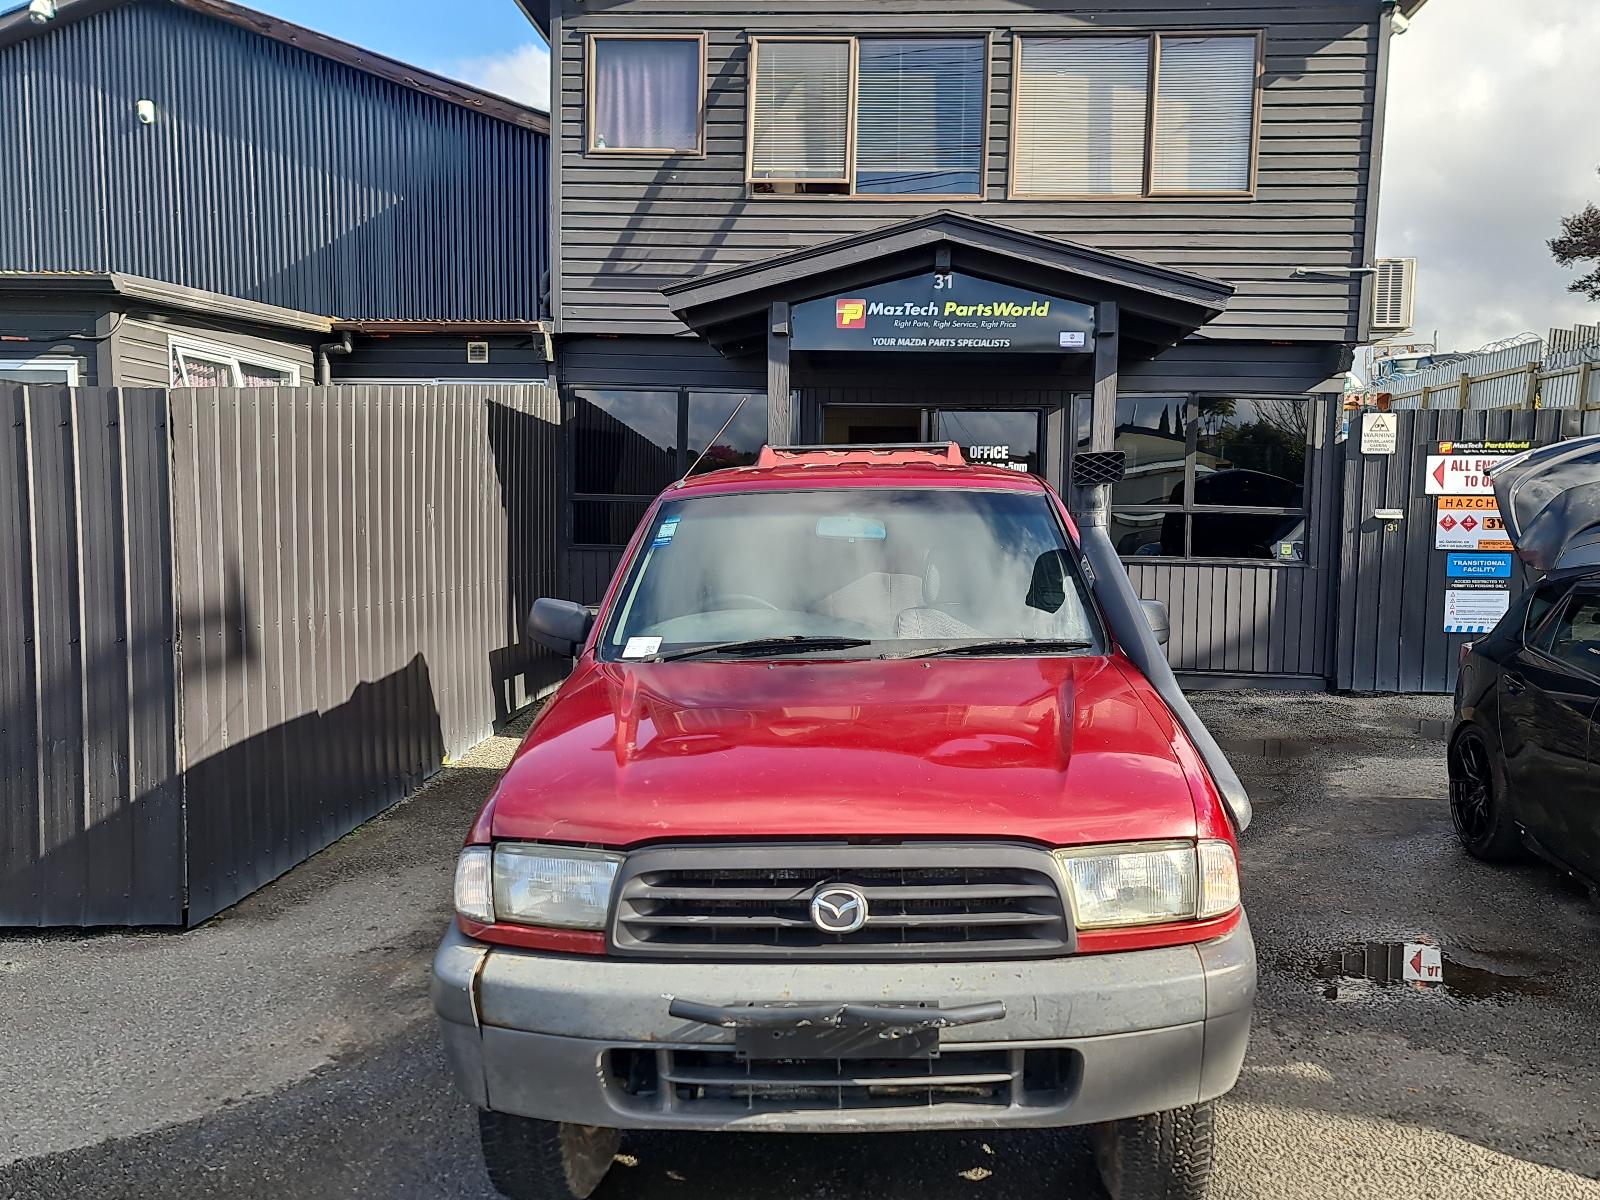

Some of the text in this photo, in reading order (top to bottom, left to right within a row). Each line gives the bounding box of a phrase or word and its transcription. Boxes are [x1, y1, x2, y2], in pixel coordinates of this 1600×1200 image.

[933, 274, 953, 289] 31
[867, 301, 1050, 317] MazTech PartsWorld
[893, 320, 1017, 330] Right Parts, Right Service, Right Price
[872, 338, 1011, 348] YOUR MAZDA PARTS SPECIALISTS
[1452, 441, 1530, 449] MazTech PartsWorld
[969, 445, 1009, 459] OFFICE
[1451, 459, 1471, 472] ALL
[1464, 475, 1478, 487] TO
[1445, 498, 1494, 508] HAZCH
[1387, 523, 1398, 532] 31
